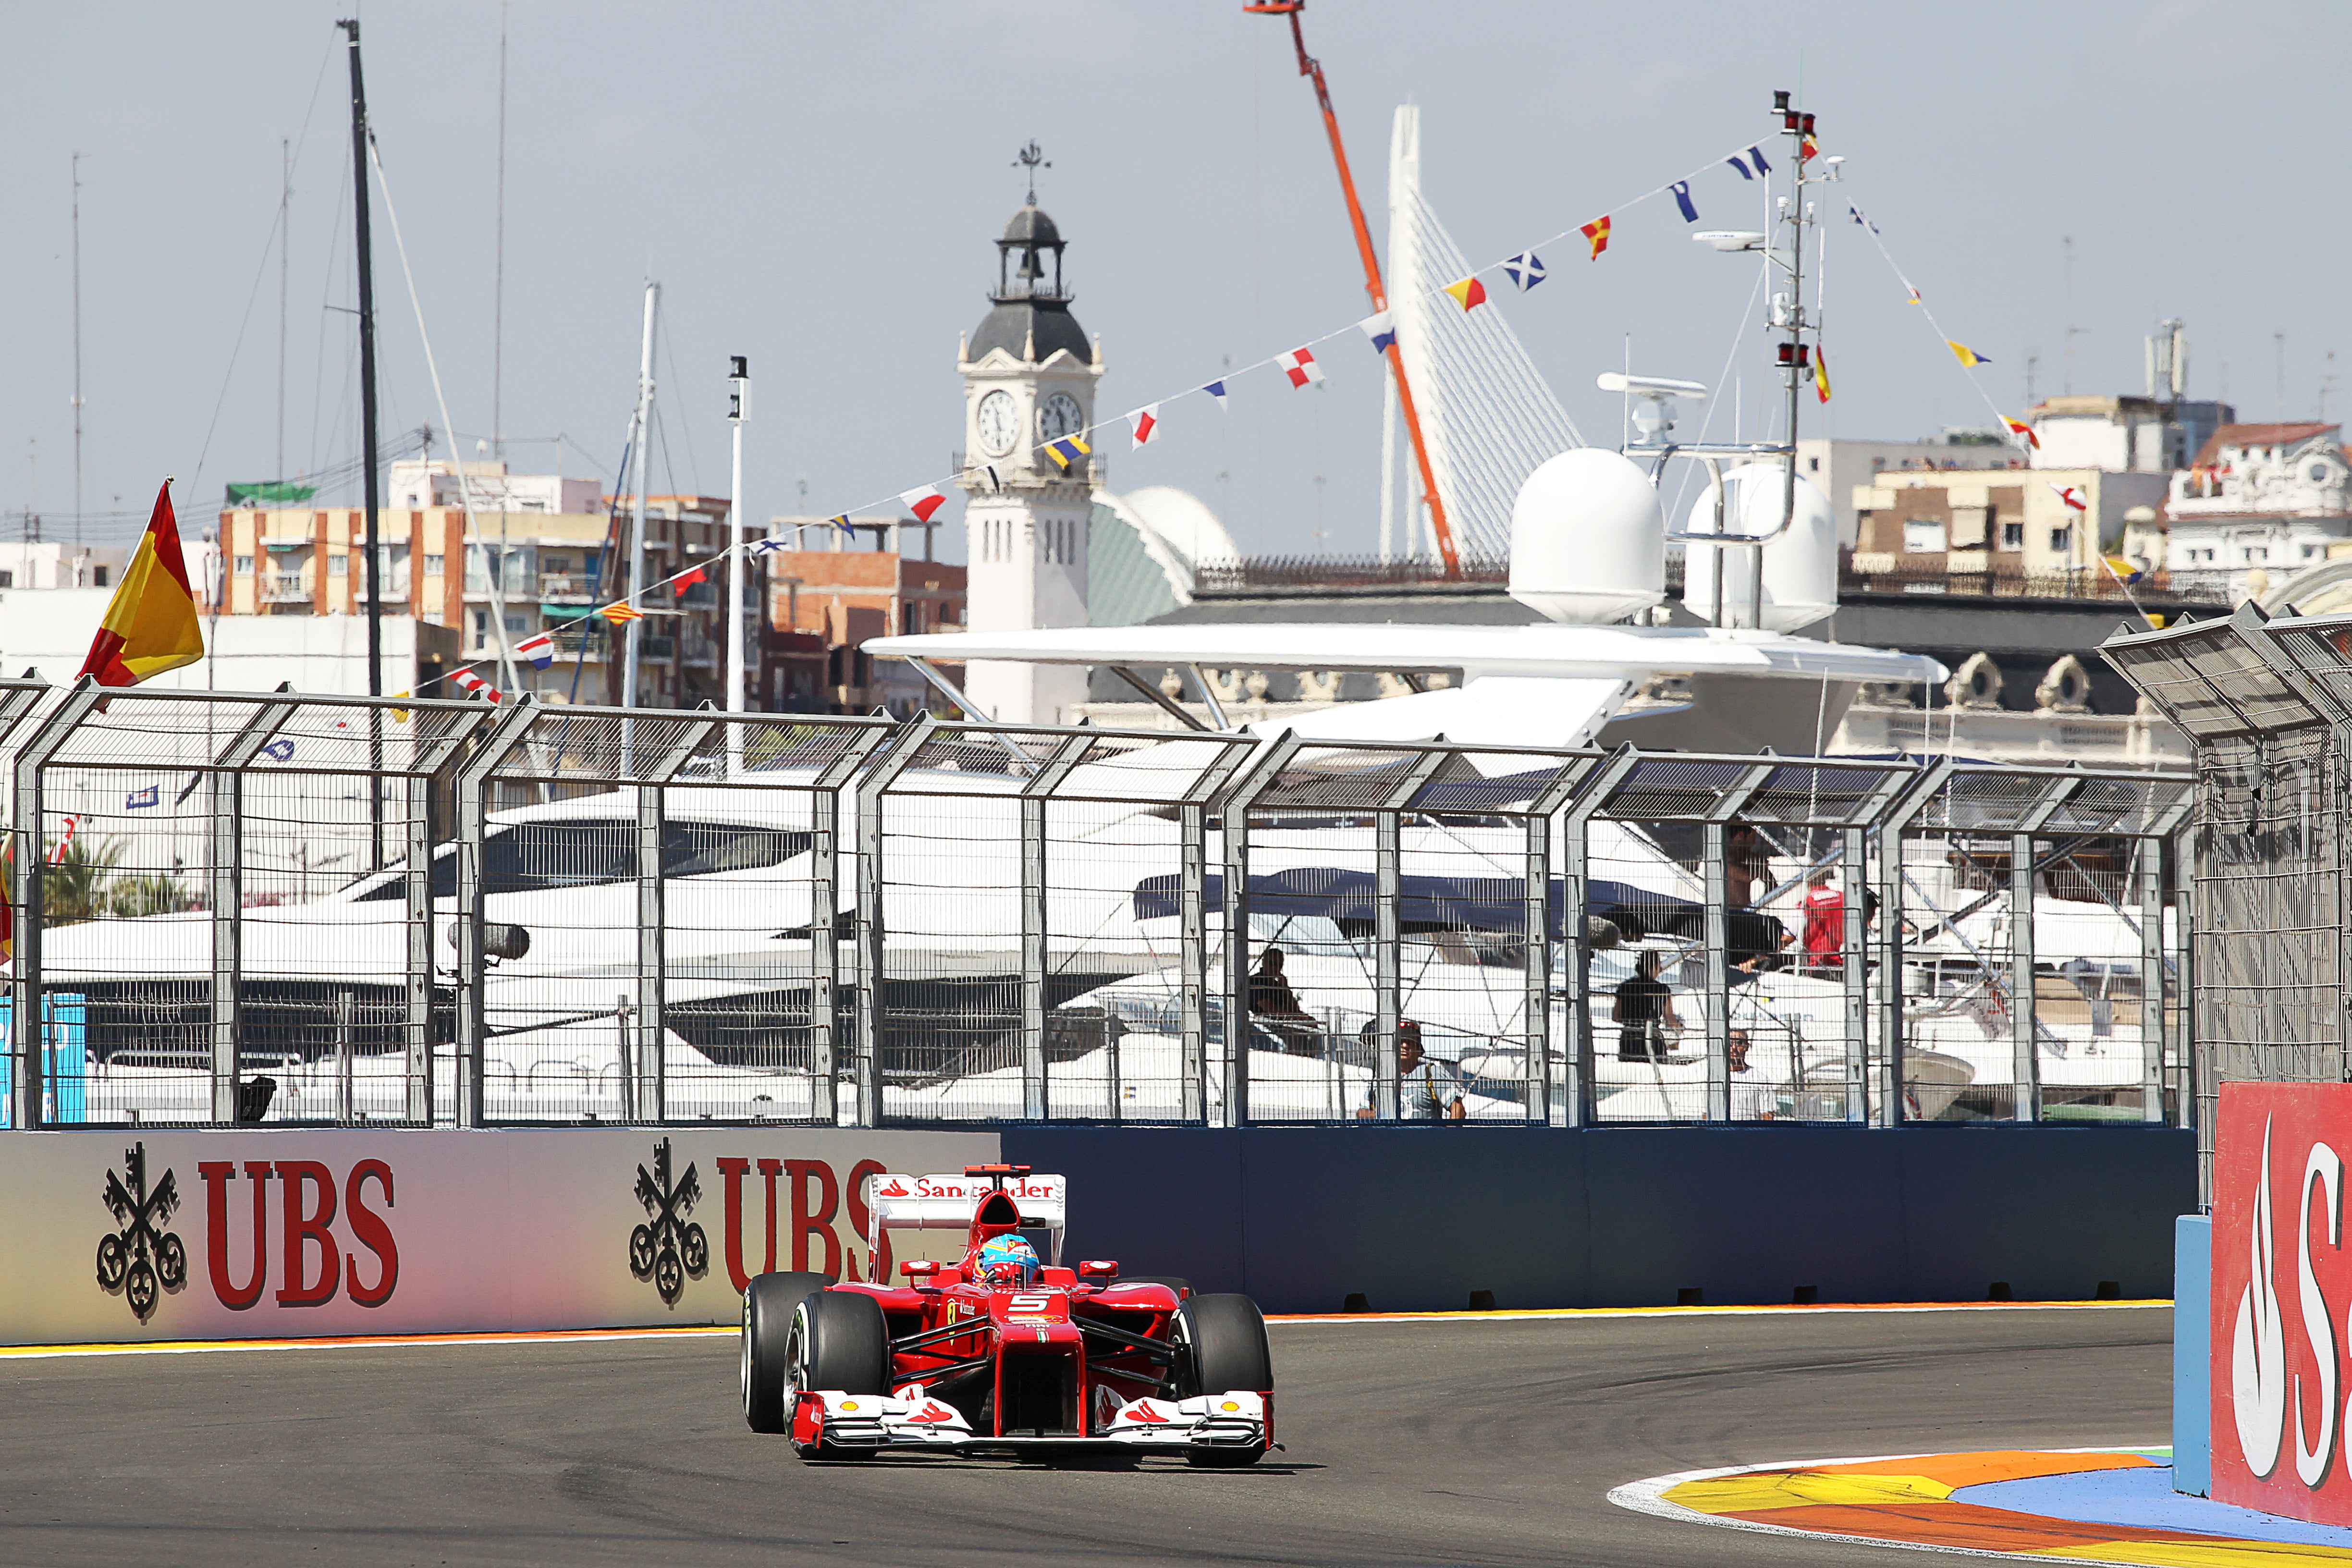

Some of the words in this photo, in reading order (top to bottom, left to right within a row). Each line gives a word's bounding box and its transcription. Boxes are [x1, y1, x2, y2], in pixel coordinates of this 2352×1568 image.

[198, 1158, 399, 1310] UBS
[716, 1157, 894, 1296] UBS
[1007, 1295, 1052, 1312] 5
[2294, 1141, 2352, 1487] S
